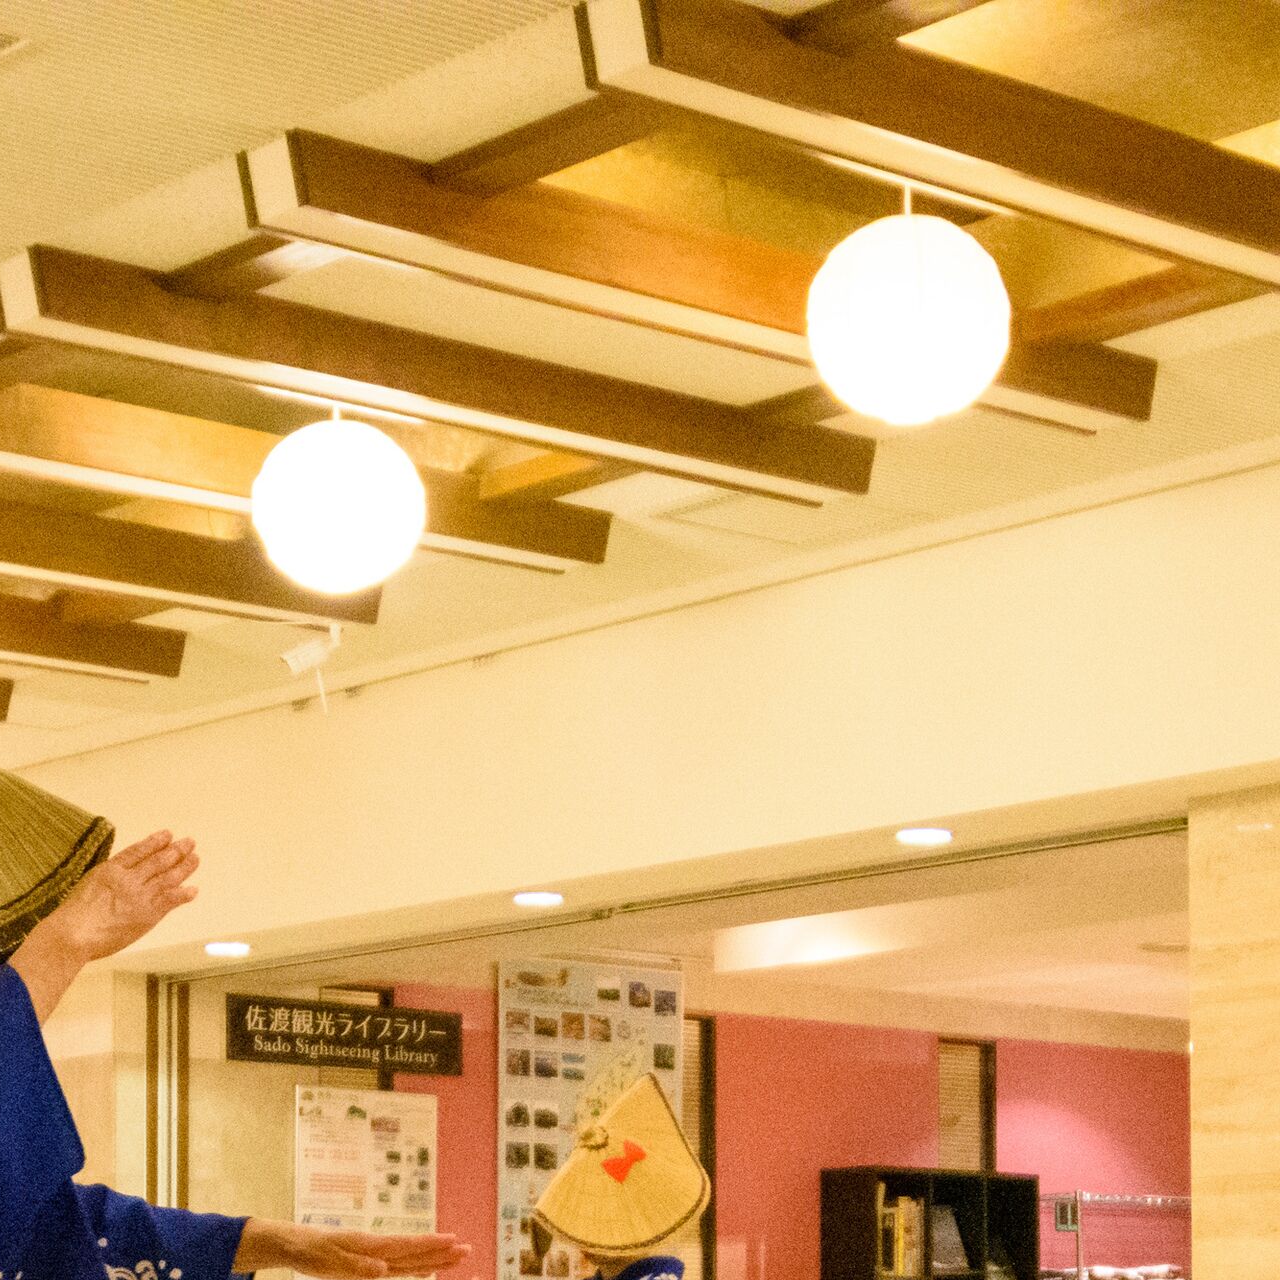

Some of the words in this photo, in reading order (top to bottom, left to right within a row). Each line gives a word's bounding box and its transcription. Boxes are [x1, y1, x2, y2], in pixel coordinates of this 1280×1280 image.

[245, 1004, 447, 1042] 佐渡観光ライブラリー
[253, 1035, 291, 1053] Sado
[295, 1037, 380, 1062] Sightseeing
[384, 1044, 439, 1066] Library
